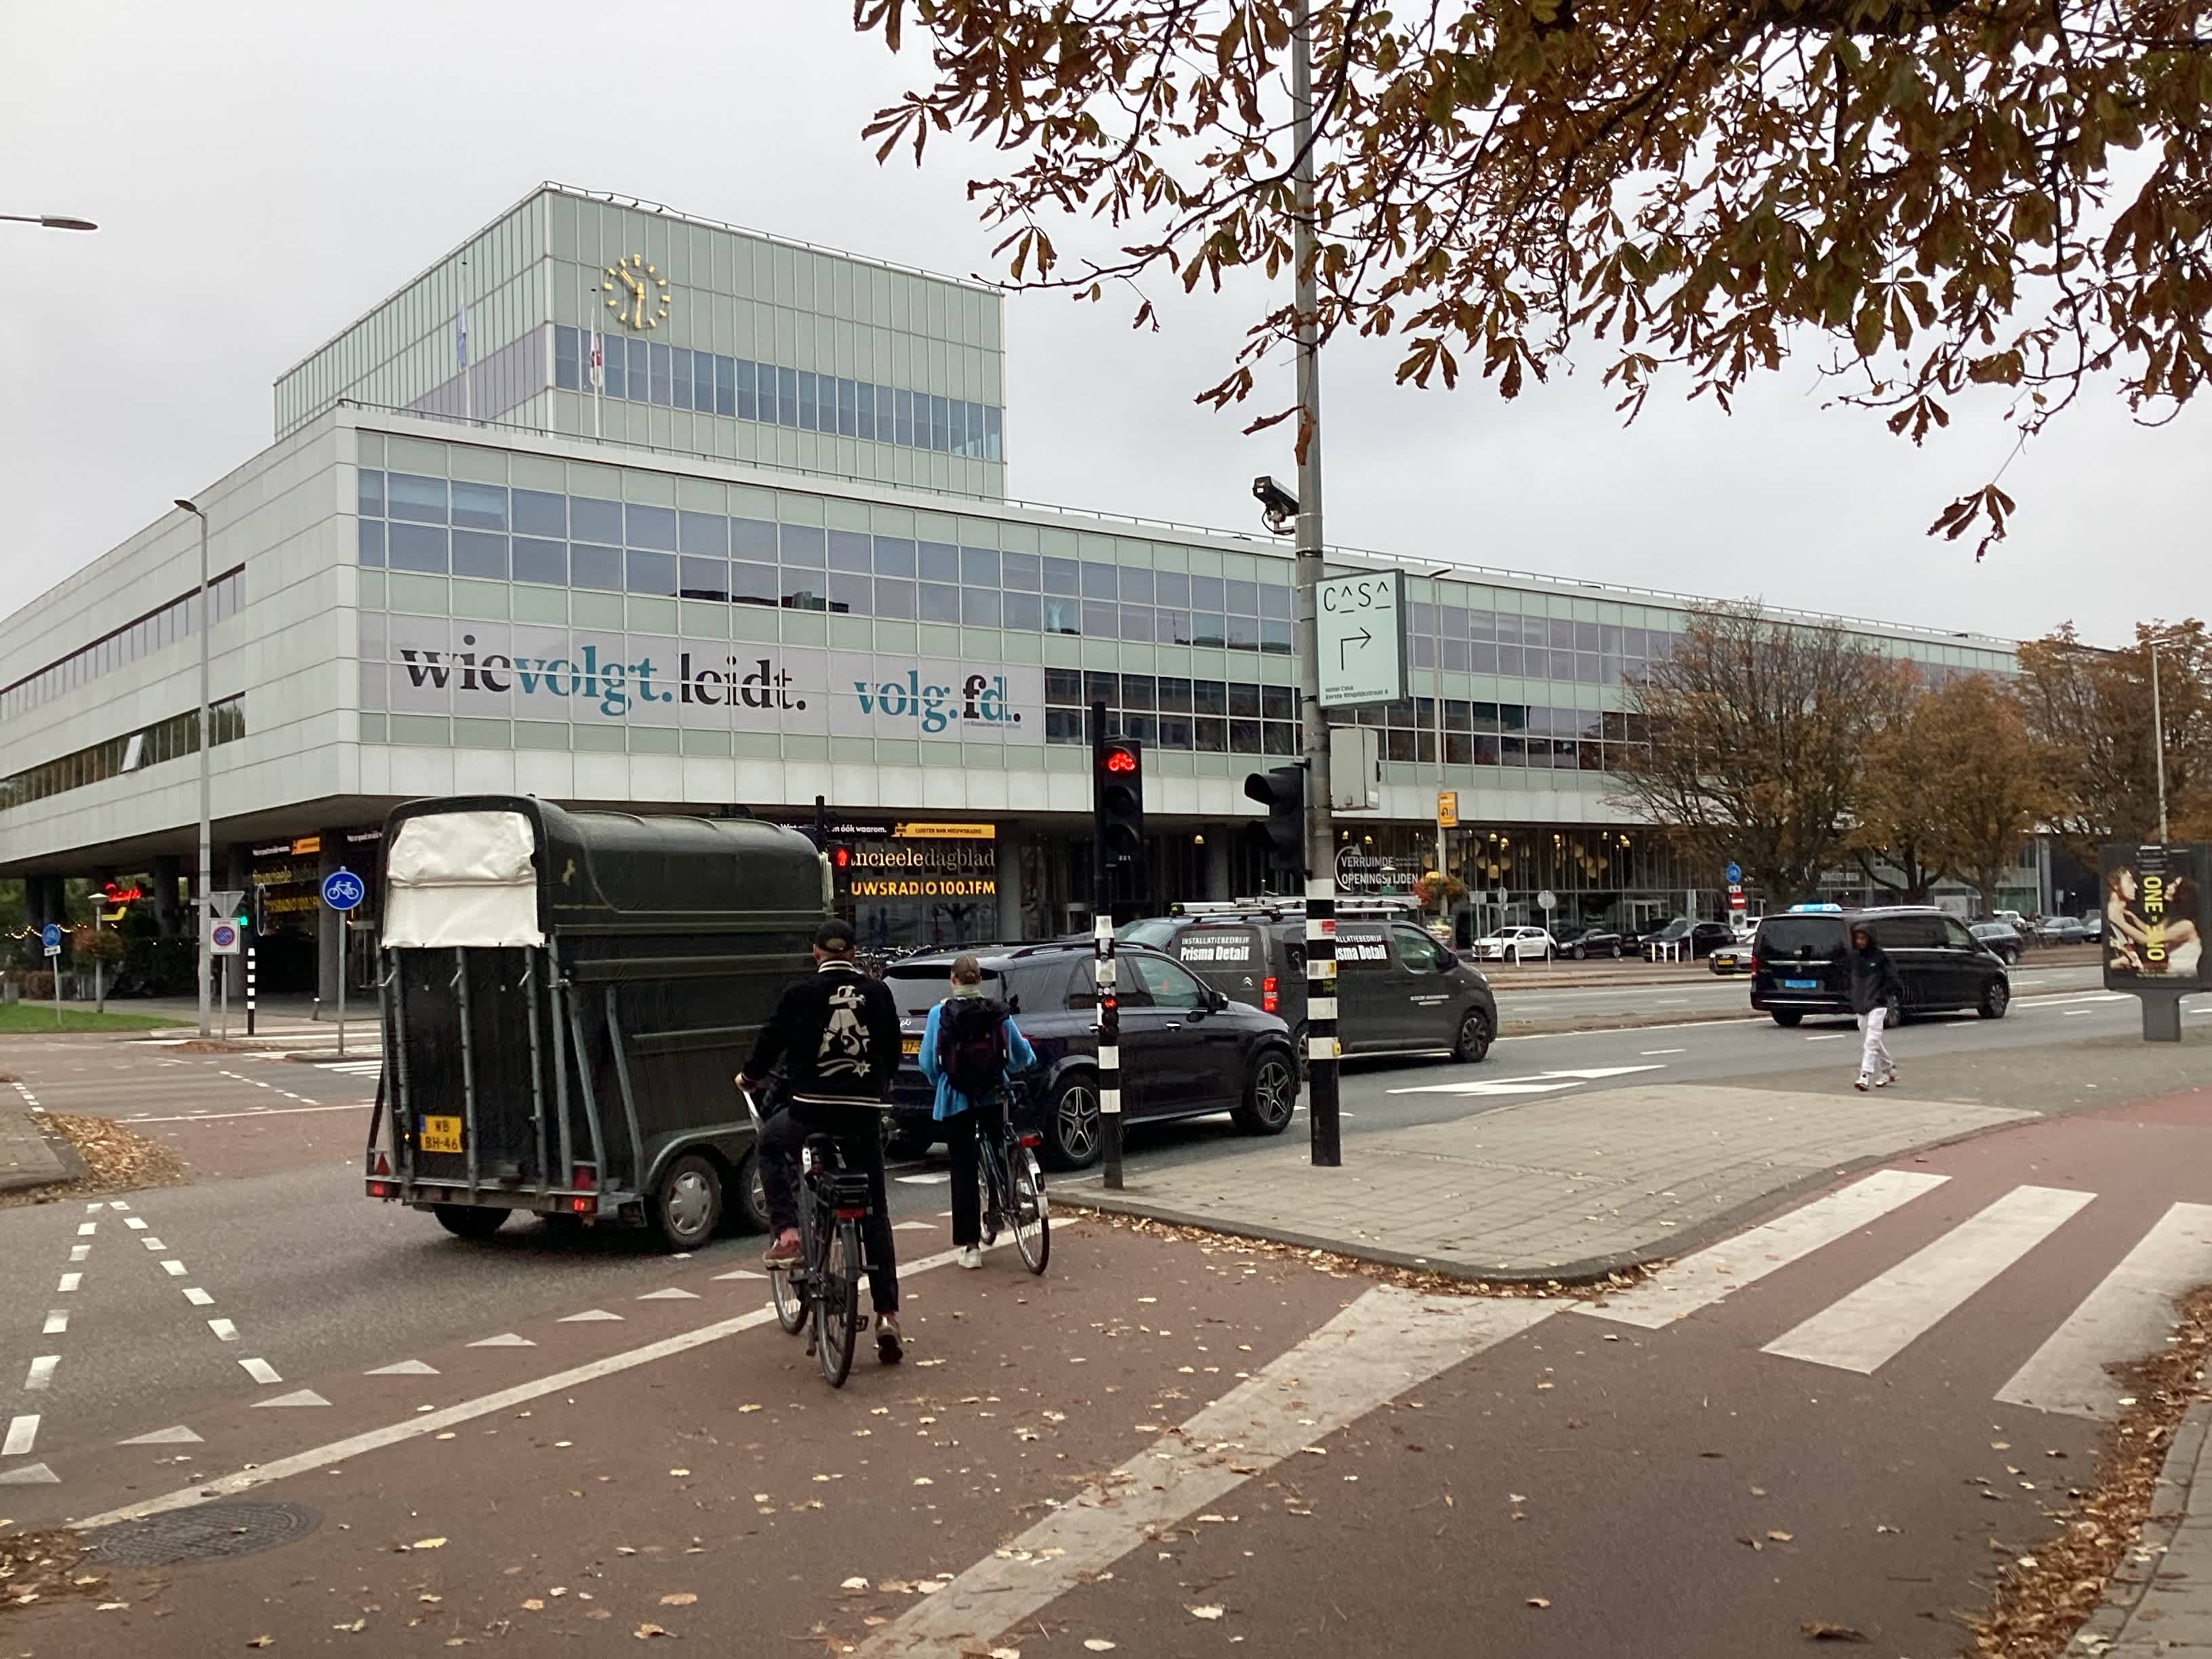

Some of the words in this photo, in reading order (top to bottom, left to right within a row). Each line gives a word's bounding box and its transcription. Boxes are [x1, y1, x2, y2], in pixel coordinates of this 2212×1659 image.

[851, 848, 996, 871] ncieeledagblad
[1341, 856, 1394, 867] VERRUIMDE
[851, 882, 937, 896] UWSRADIO
[2143, 876, 2164, 914] ONE
[1181, 937, 1250, 945] INSTALLATIEBEDRIJF
[1334, 935, 1382, 943] ALLATIEBEDRIJF
[1180, 946, 1214, 961] Prisma
[1215, 945, 1249, 960] Detail
[1334, 945, 1359, 960] isma
[1357, 944, 1387, 960] Detail
